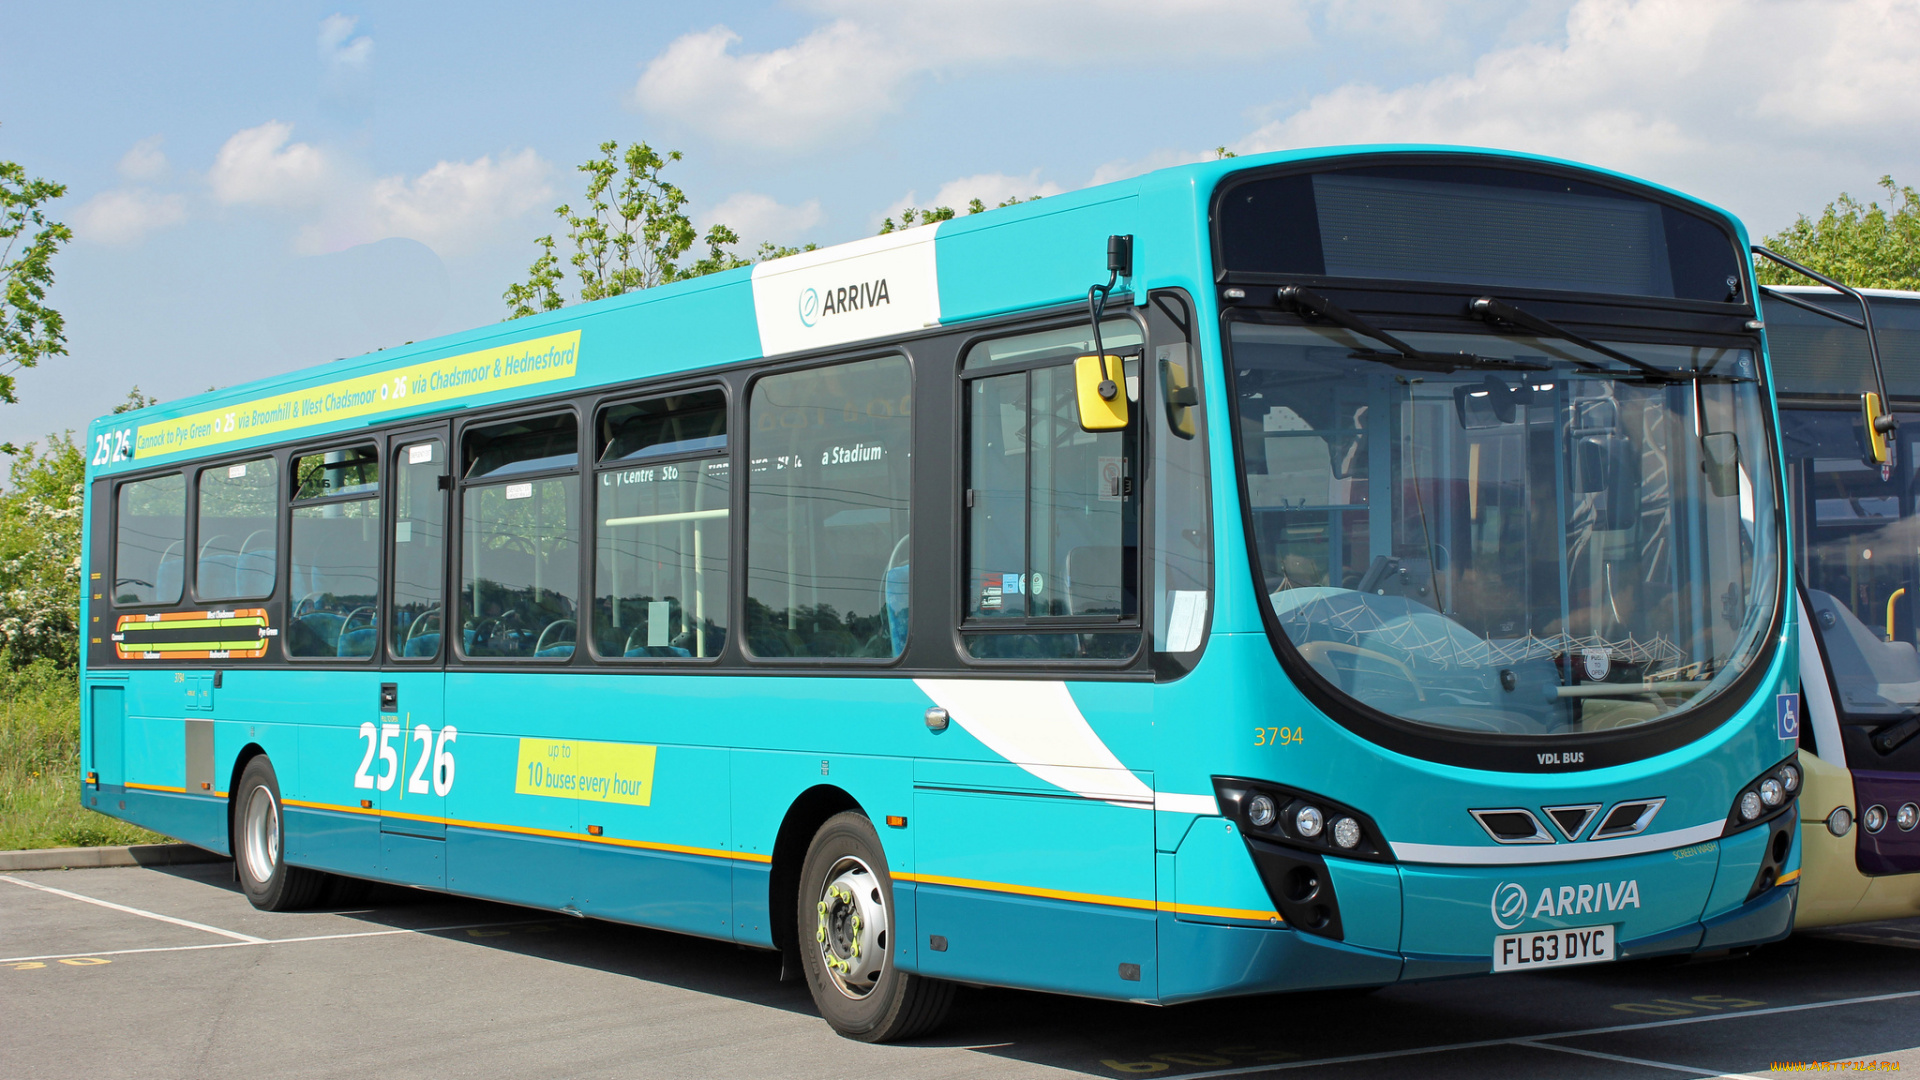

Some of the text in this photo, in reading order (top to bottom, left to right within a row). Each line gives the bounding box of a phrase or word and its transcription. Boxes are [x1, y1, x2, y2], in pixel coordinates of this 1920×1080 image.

[822, 279, 890, 316] ARRIVA
[137, 342, 576, 450] Cannock to Pye Green 25 via Broomhill & West Chadsmoor 26 via Chadsmoor & Hednesford
[92, 432, 112, 466] 25
[831, 443, 882, 465] Stadium
[548, 742, 571, 761] up to
[1253, 726, 1304, 746] 3794
[354, 721, 458, 797] 25 26
[1537, 751, 1584, 765] VDL BUS
[527, 761, 642, 798] 10 buses every hour
[1672, 842, 1718, 860] SCREEN WASH
[1532, 879, 1641, 919] ARRIVA
[1503, 930, 1605, 966] FL63 DYC
